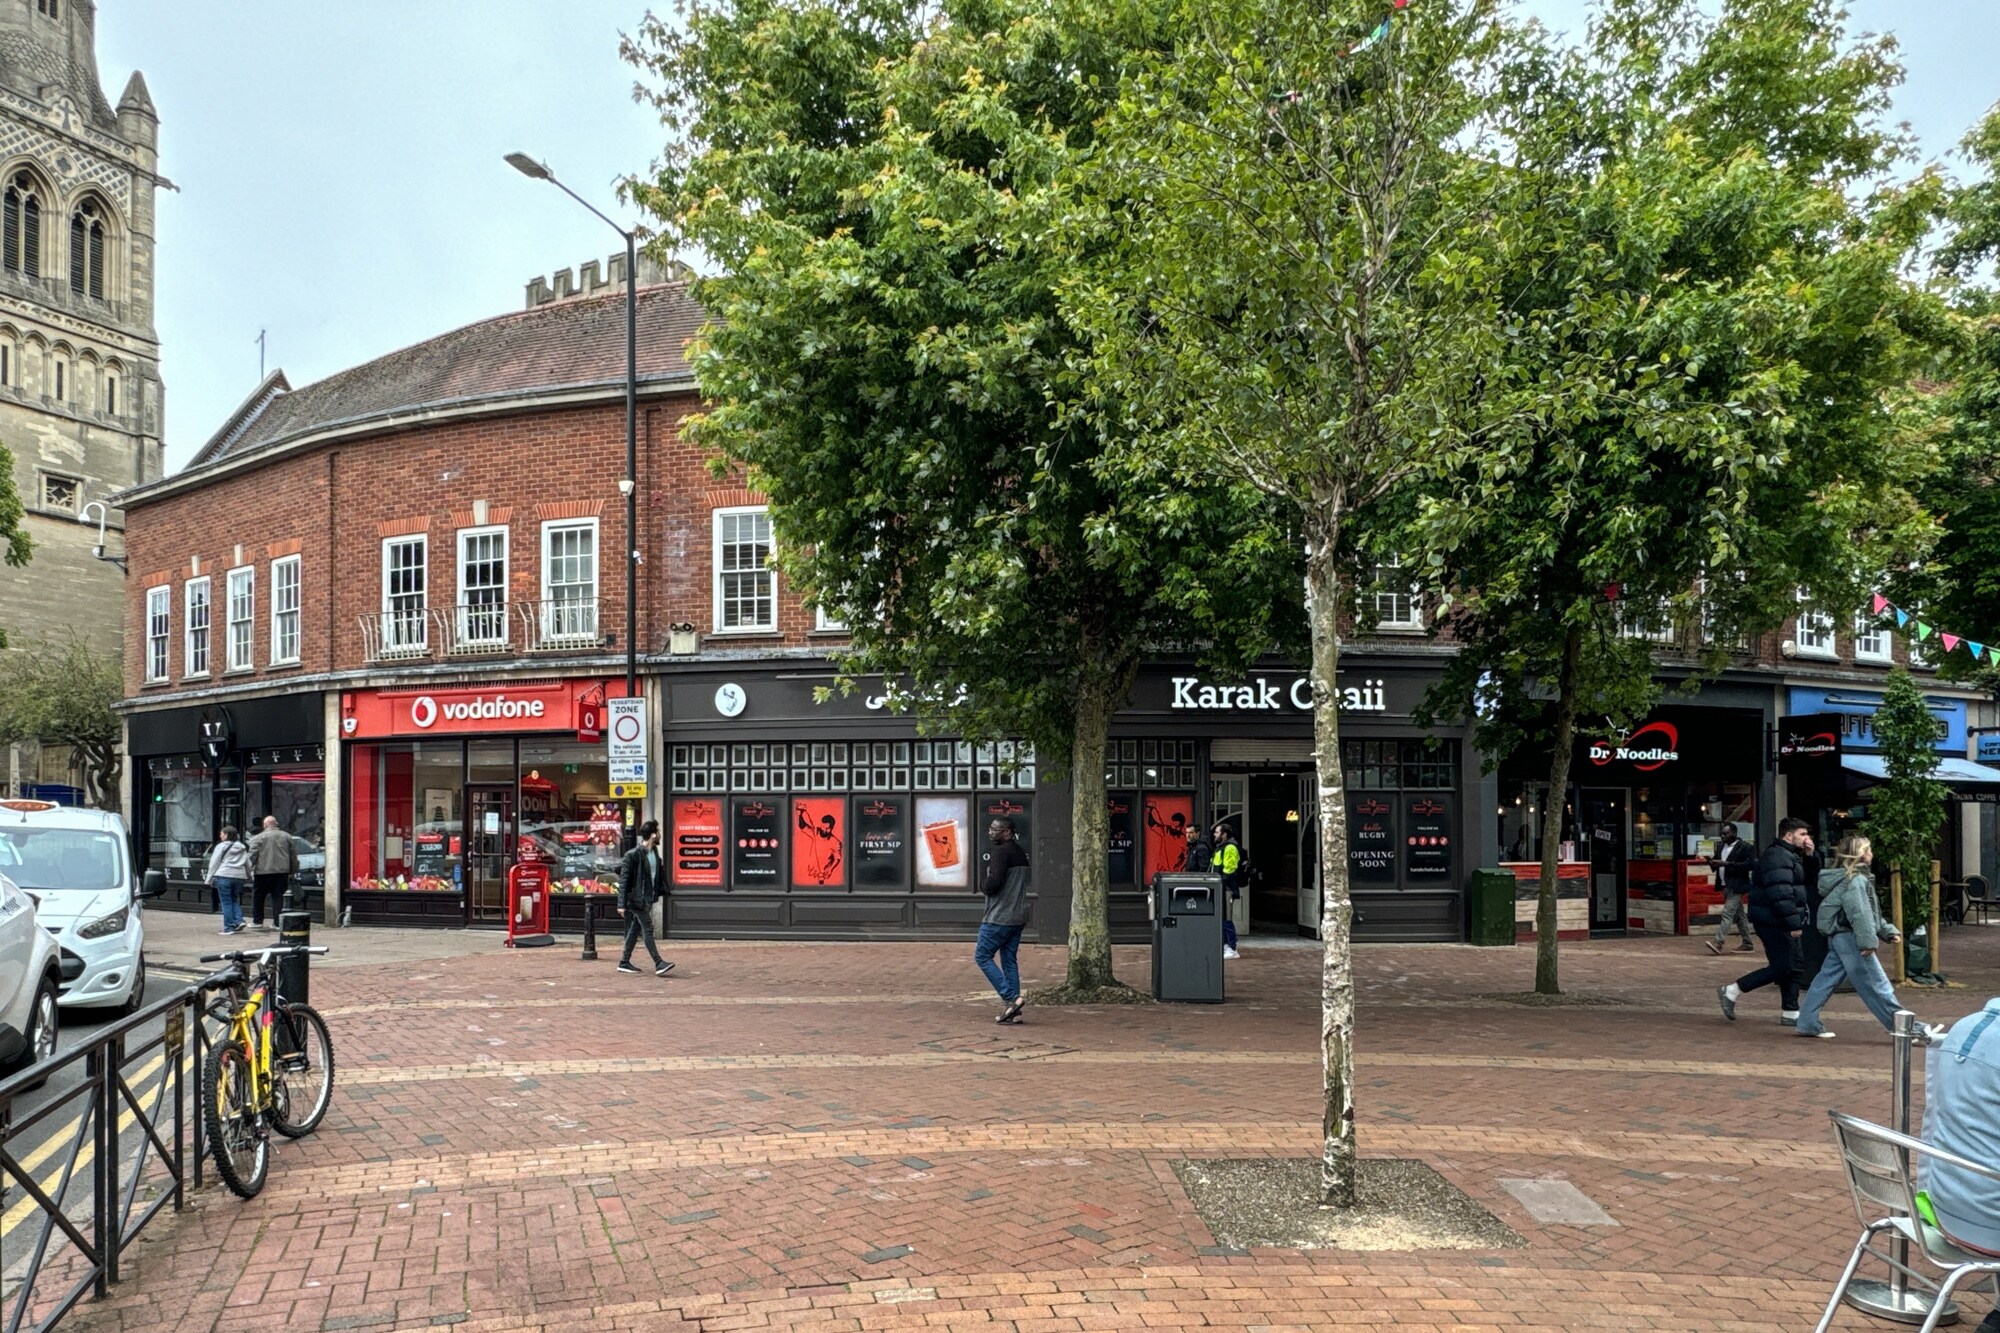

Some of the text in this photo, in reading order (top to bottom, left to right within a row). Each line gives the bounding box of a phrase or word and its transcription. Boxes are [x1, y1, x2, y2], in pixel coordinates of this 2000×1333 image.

[1171, 677, 1386, 710] Karak Caii
[442, 696, 545, 720] vodafone
[1589, 747, 1679, 761] Dr Noodles
[1781, 744, 1836, 754] Dr Noodles
[1350, 851, 1395, 859] OPENING
[1359, 860, 1387, 868] SOON
